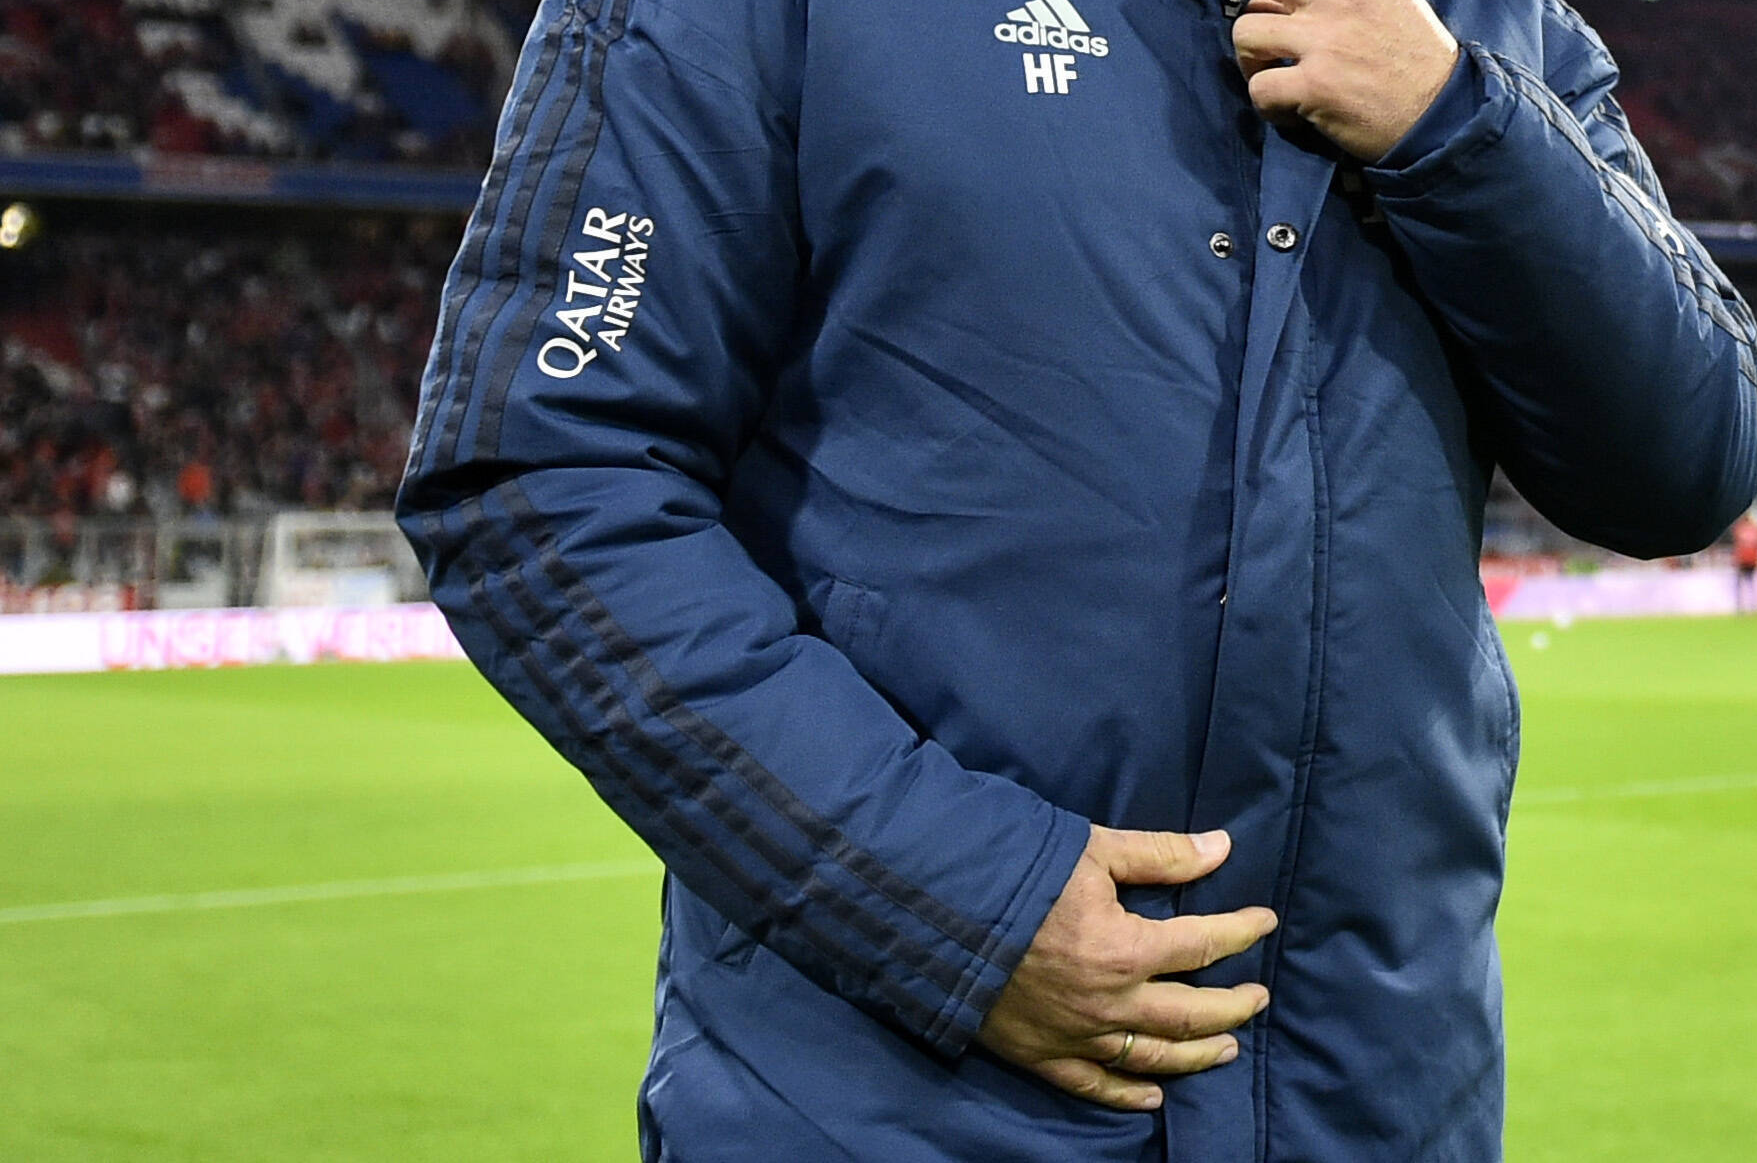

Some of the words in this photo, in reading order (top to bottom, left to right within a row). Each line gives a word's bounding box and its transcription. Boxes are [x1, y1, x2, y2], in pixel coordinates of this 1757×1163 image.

[994, 21, 1109, 57] adidas
[1022, 52, 1078, 95] HF
[536, 207, 628, 379] QATAR
[596, 215, 655, 352] AIRWAYS
